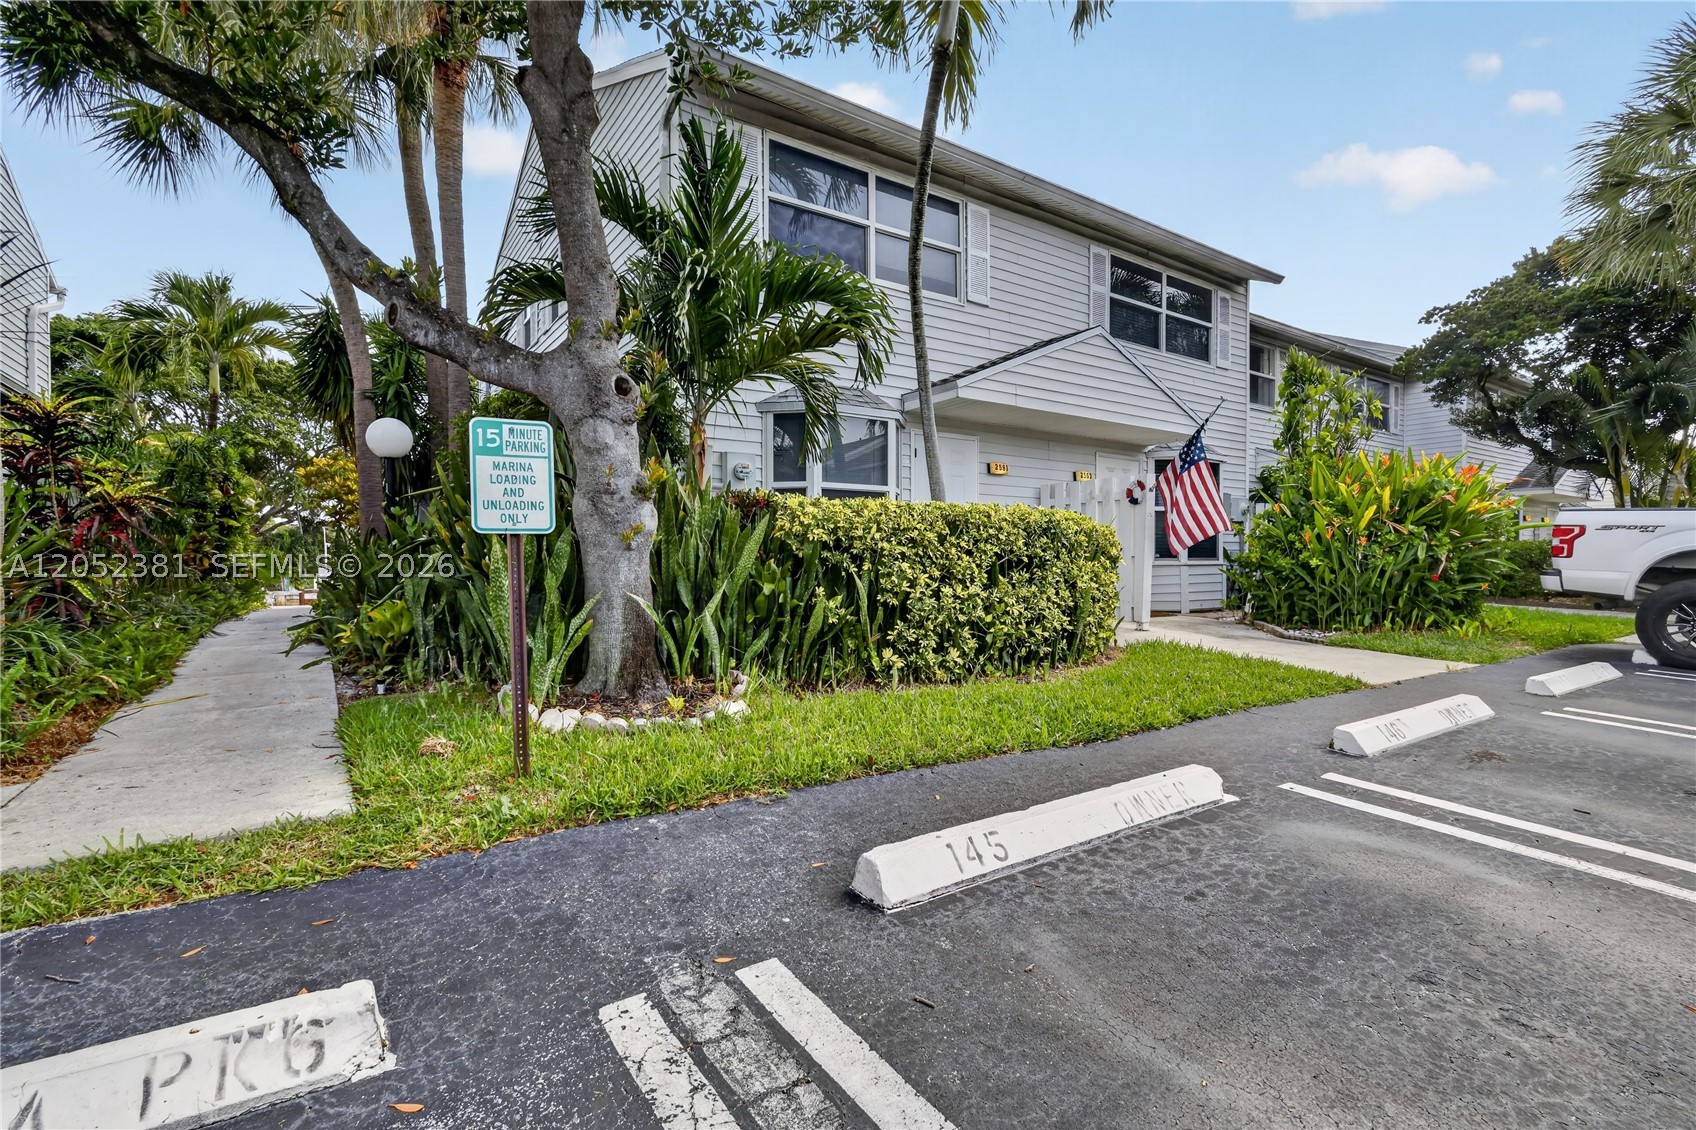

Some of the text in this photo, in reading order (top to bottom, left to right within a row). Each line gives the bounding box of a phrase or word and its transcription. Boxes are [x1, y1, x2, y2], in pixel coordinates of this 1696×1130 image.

[476, 428, 501, 448] 15
[508, 427, 543, 441] MINUTE
[505, 440, 546, 453] PARKING
[492, 461, 534, 473] MARINA
[489, 474, 537, 485] LOADING
[502, 488, 525, 498] AND
[482, 500, 545, 511] UNLOADING
[500, 513, 529, 524] ONLY
[945, 781, 1196, 874] 145 OWNER
